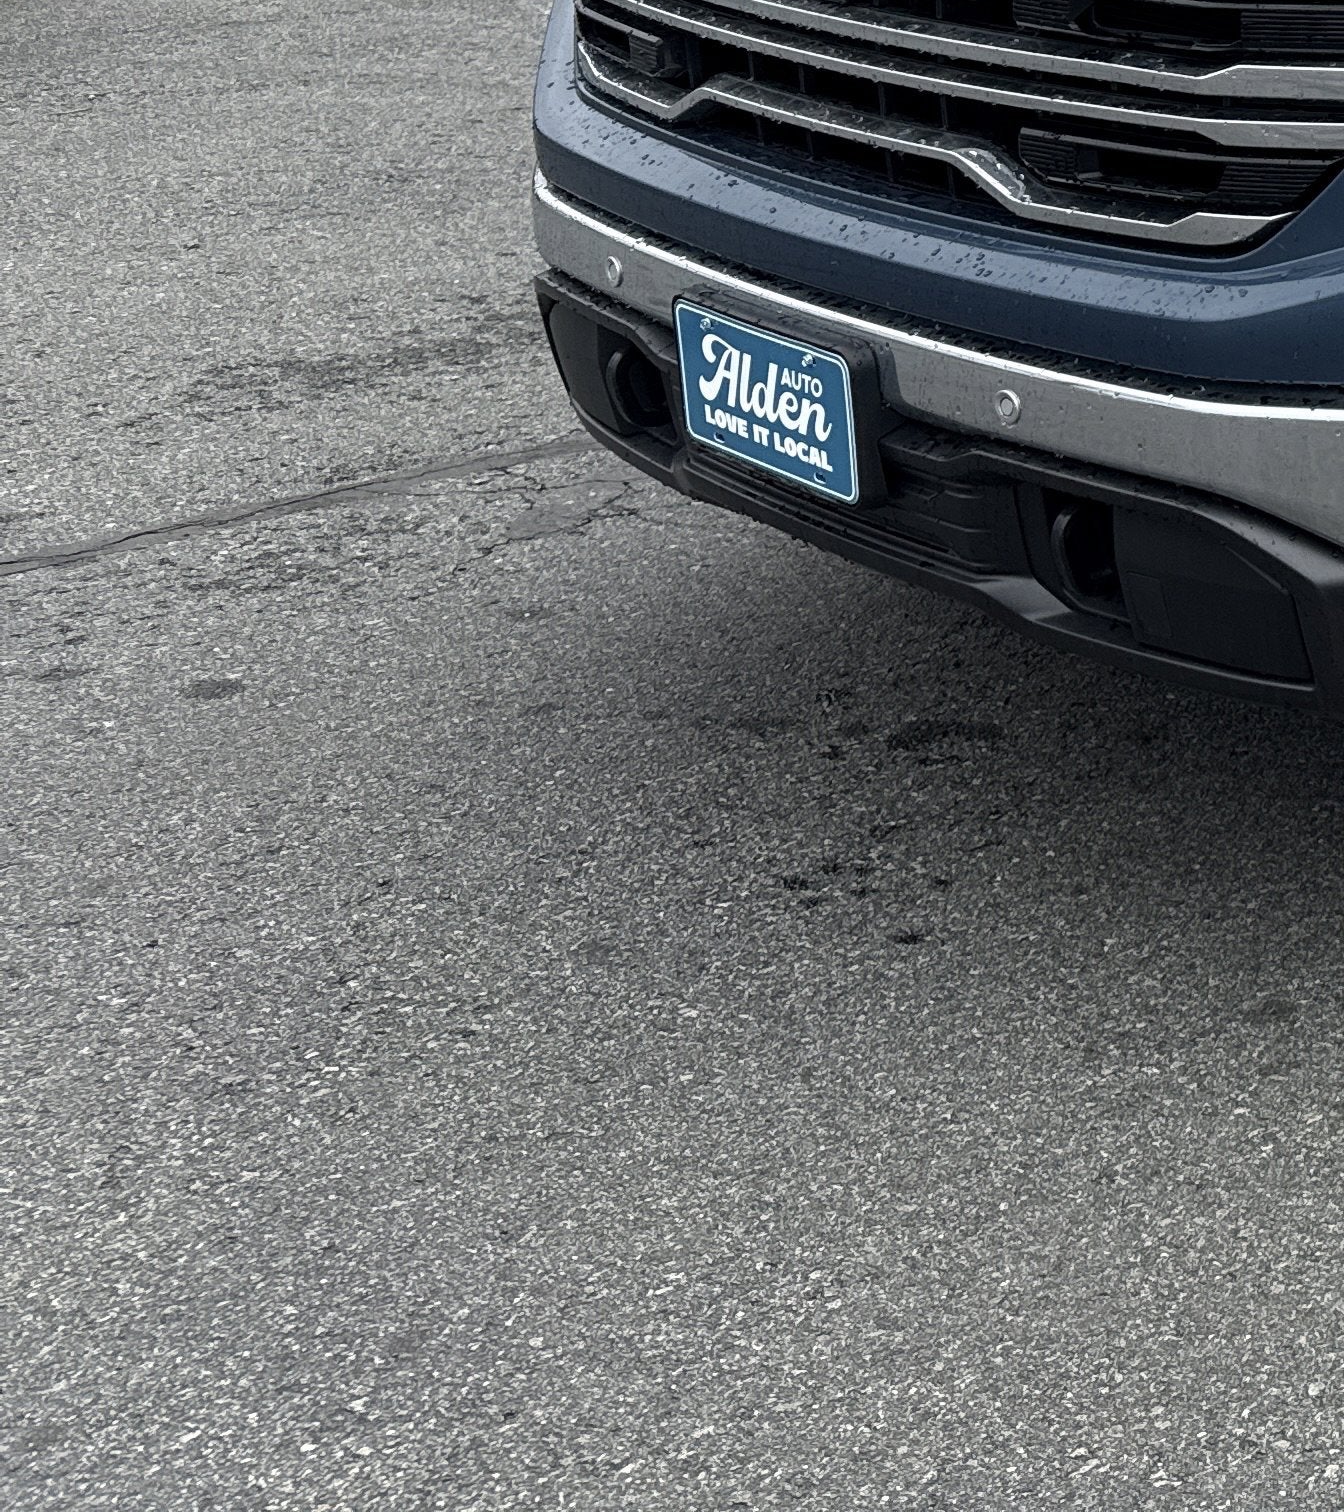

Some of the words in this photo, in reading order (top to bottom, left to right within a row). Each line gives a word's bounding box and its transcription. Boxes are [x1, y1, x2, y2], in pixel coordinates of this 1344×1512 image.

[699, 333, 833, 442] Alden
[780, 367, 823, 398] AUTO
[704, 403, 749, 439] LOVE
[752, 423, 770, 448] IT
[773, 431, 834, 473] LOCAL
